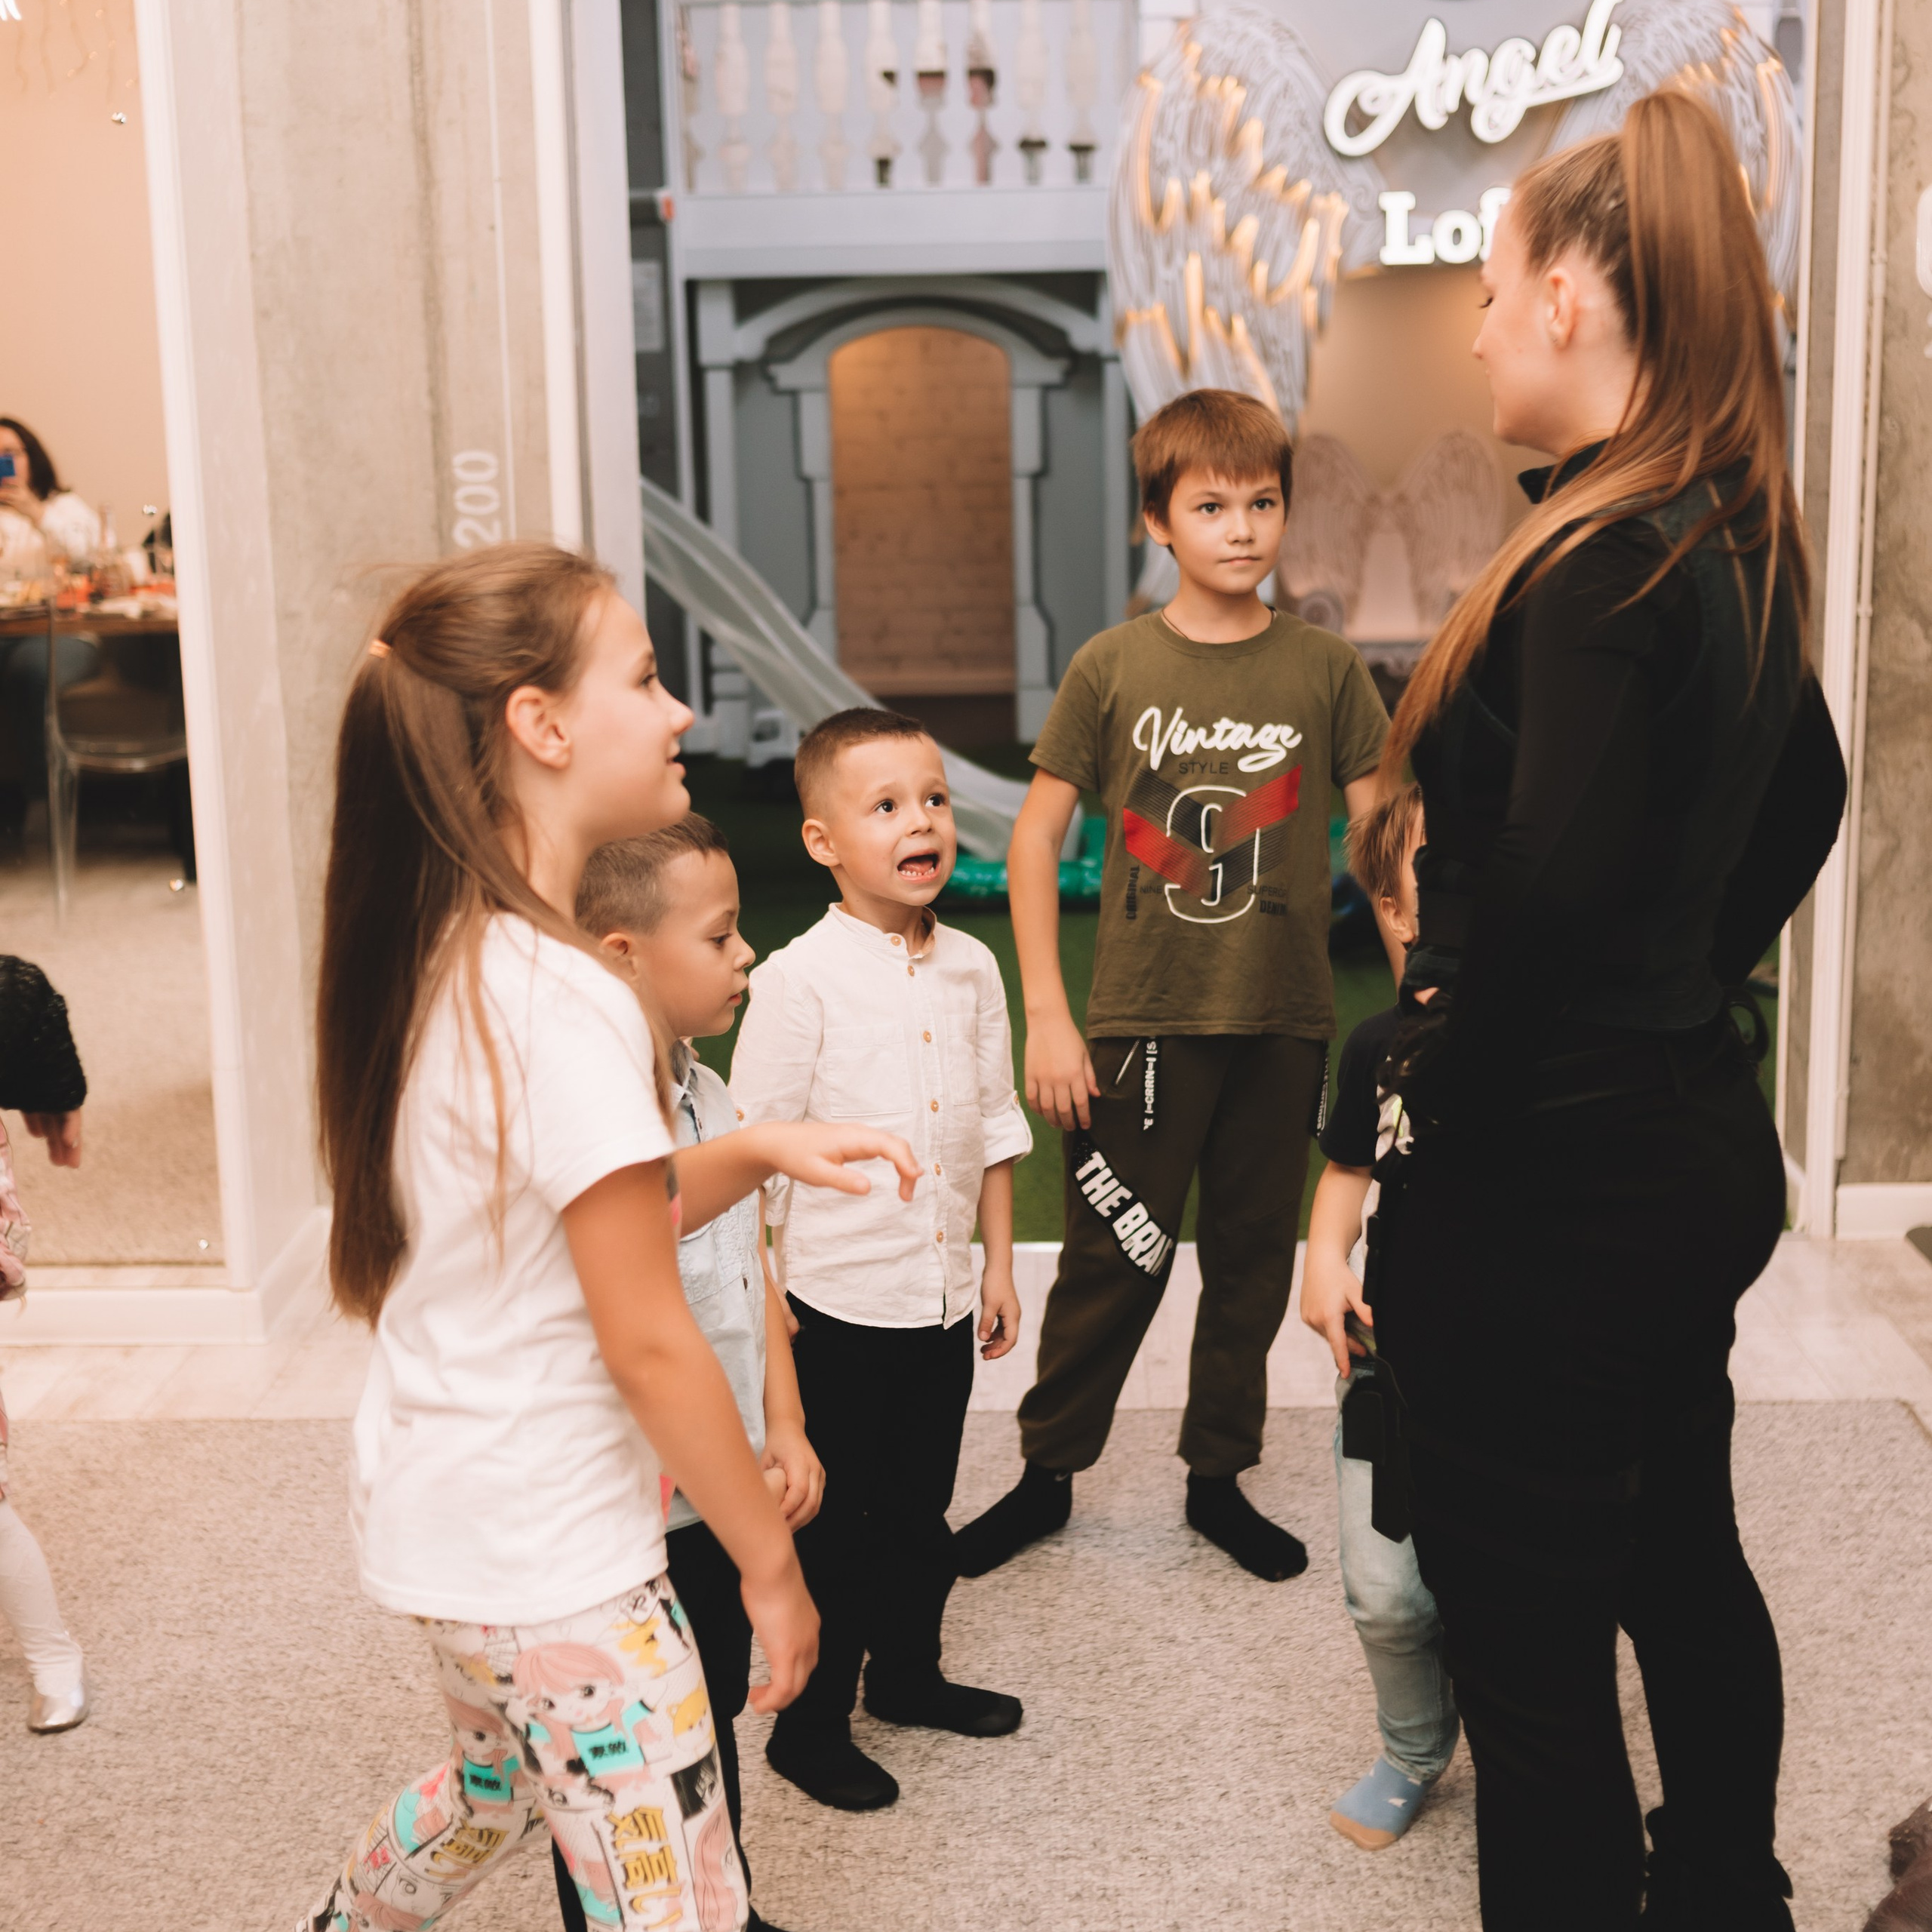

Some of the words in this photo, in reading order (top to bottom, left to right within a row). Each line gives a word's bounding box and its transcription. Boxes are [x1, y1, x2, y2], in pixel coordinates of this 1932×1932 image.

[1324, 0, 1624, 157] Angel
[452, 450, 502, 549] 200
[1133, 706, 1303, 773] Vintage
[1178, 761, 1229, 774] STYLE
[1140, 884, 1163, 894] NINE
[1075, 1150, 1133, 1218] THE
